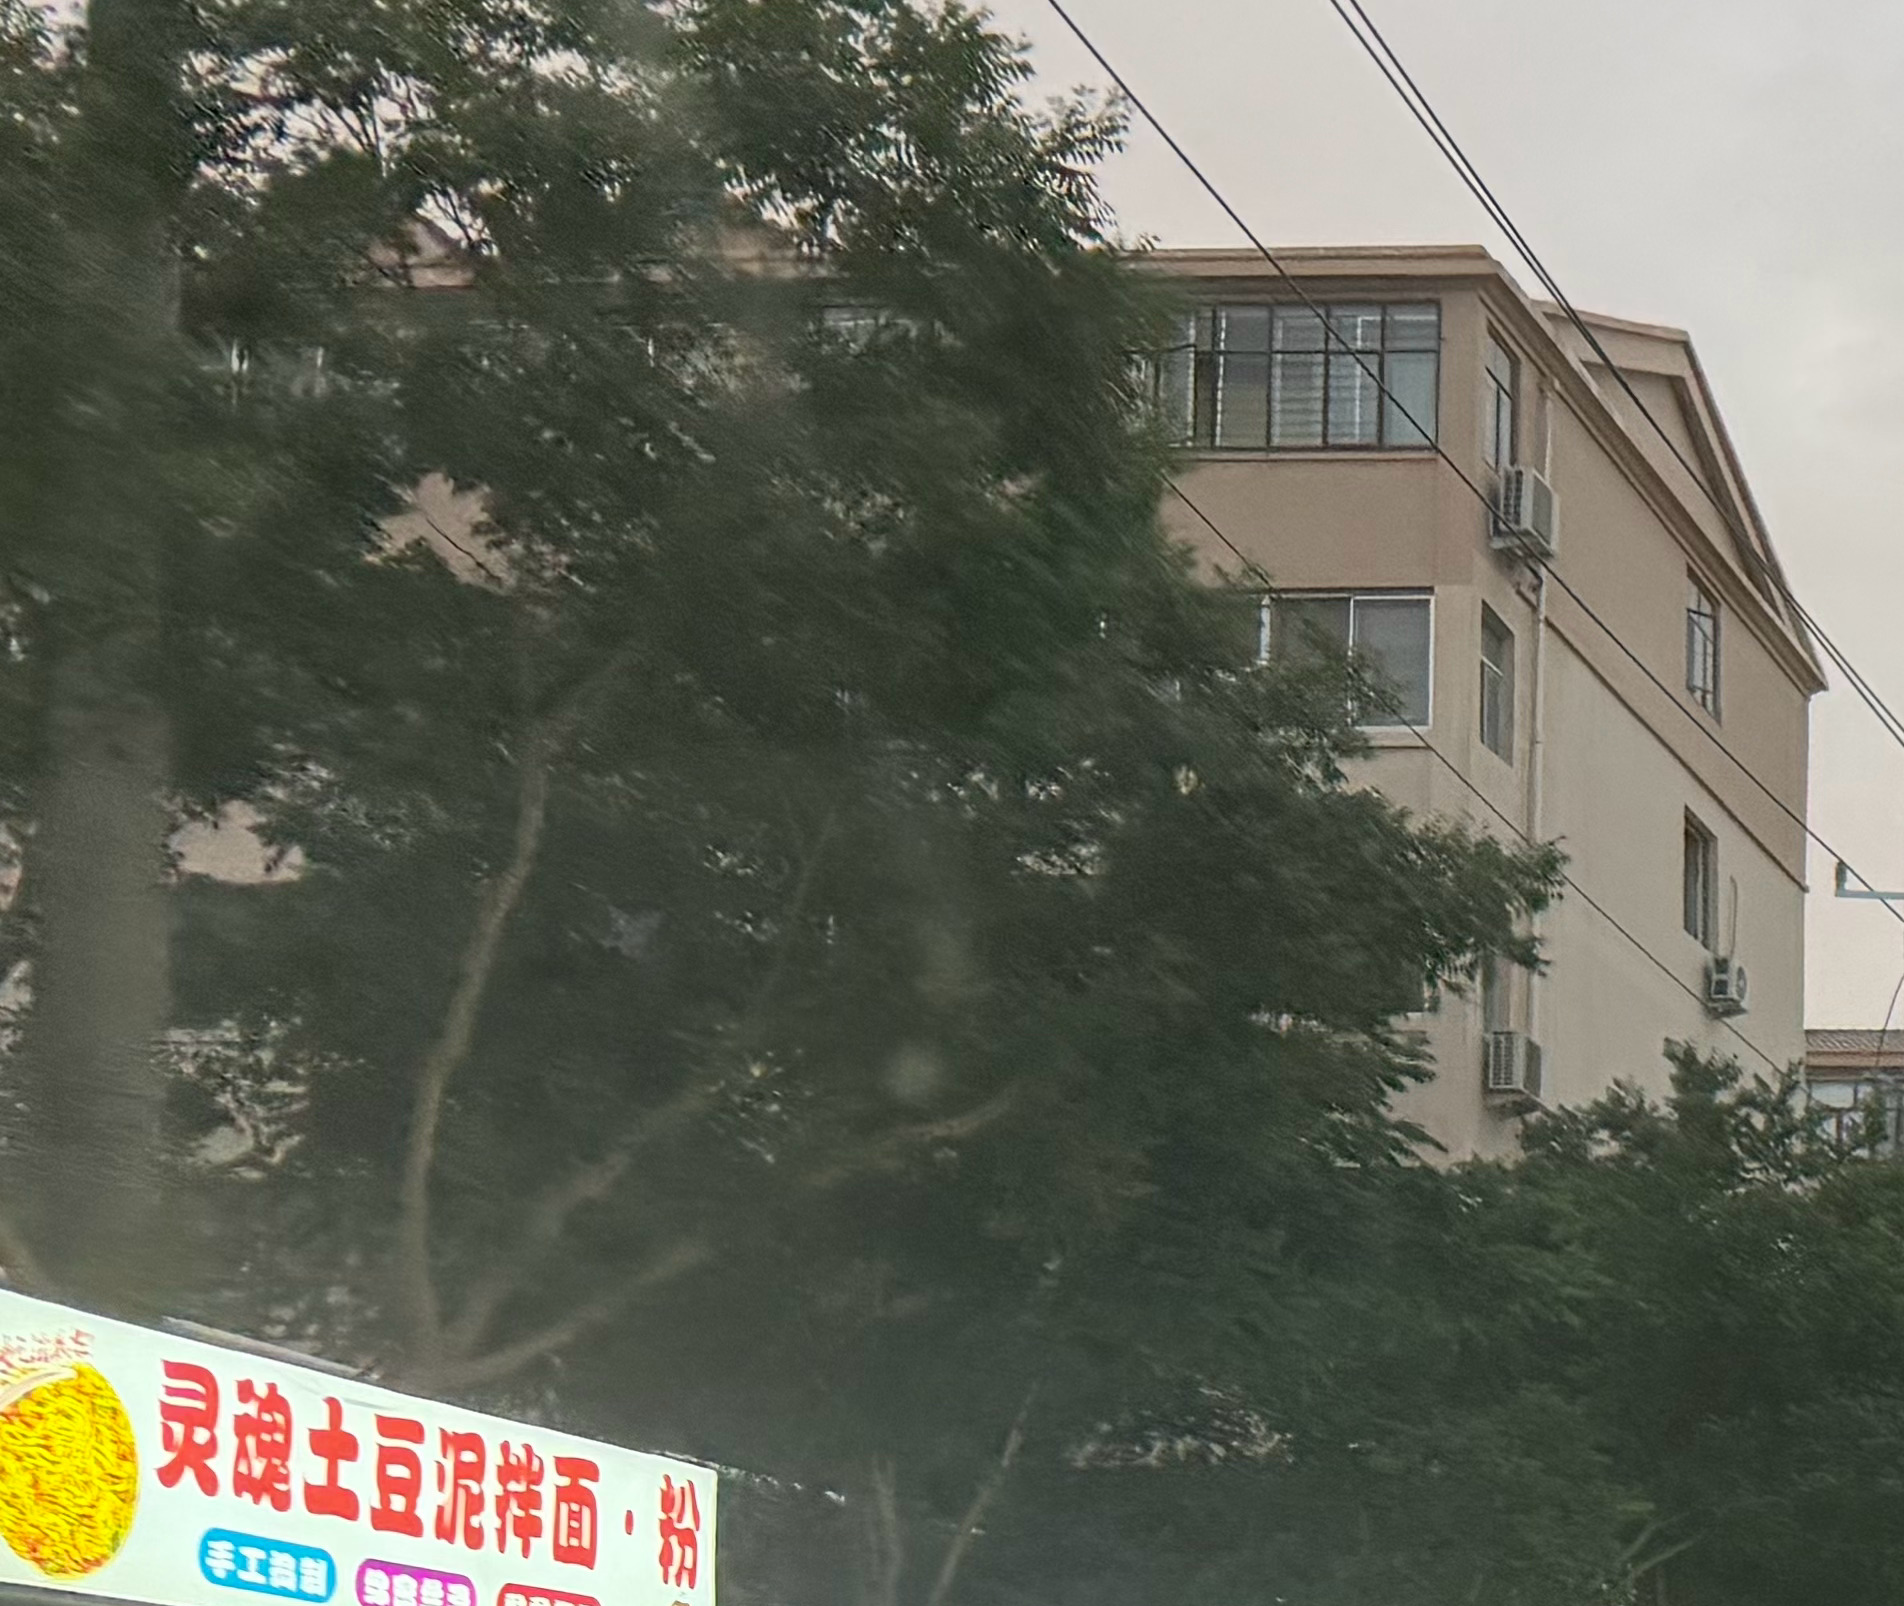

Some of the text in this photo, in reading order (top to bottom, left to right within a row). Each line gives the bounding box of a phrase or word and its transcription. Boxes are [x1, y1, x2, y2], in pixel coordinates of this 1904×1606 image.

[154, 1358, 700, 1590] 灵魂土豆泥拌面·粉
